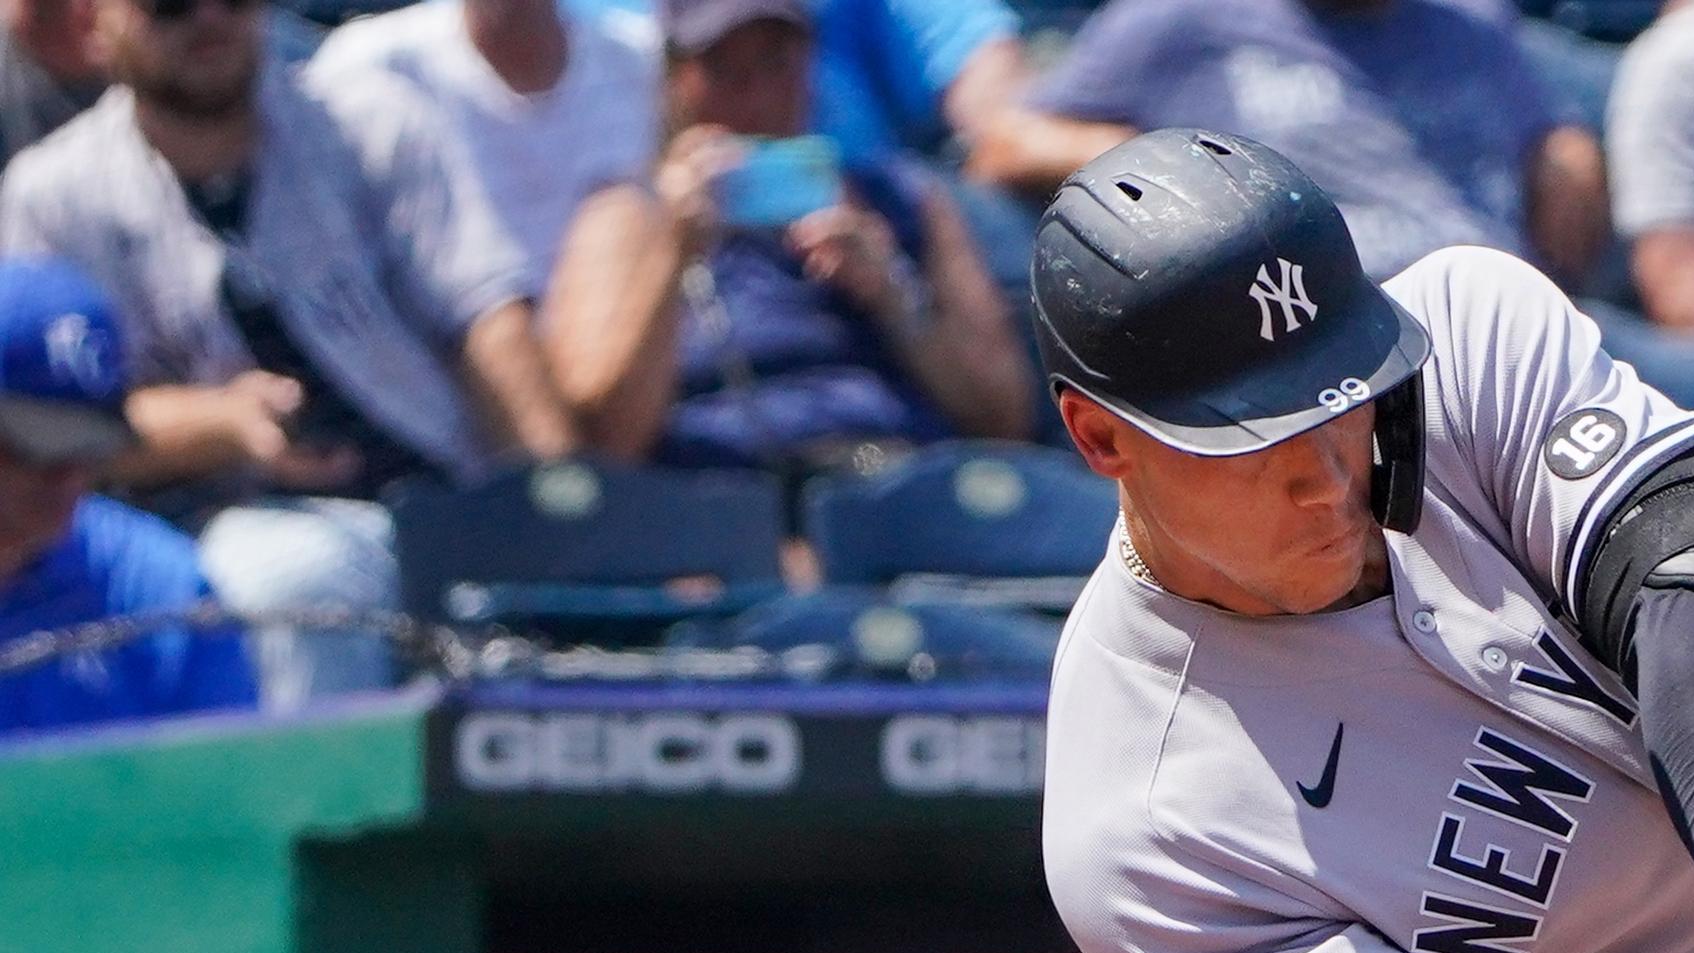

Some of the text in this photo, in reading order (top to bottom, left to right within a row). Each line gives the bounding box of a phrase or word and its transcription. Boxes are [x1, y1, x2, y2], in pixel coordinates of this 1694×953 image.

[1248, 257, 1318, 342] NY
[1317, 376, 1371, 413] 99
[1551, 414, 1618, 471] 16
[456, 712, 801, 791] GEICO
